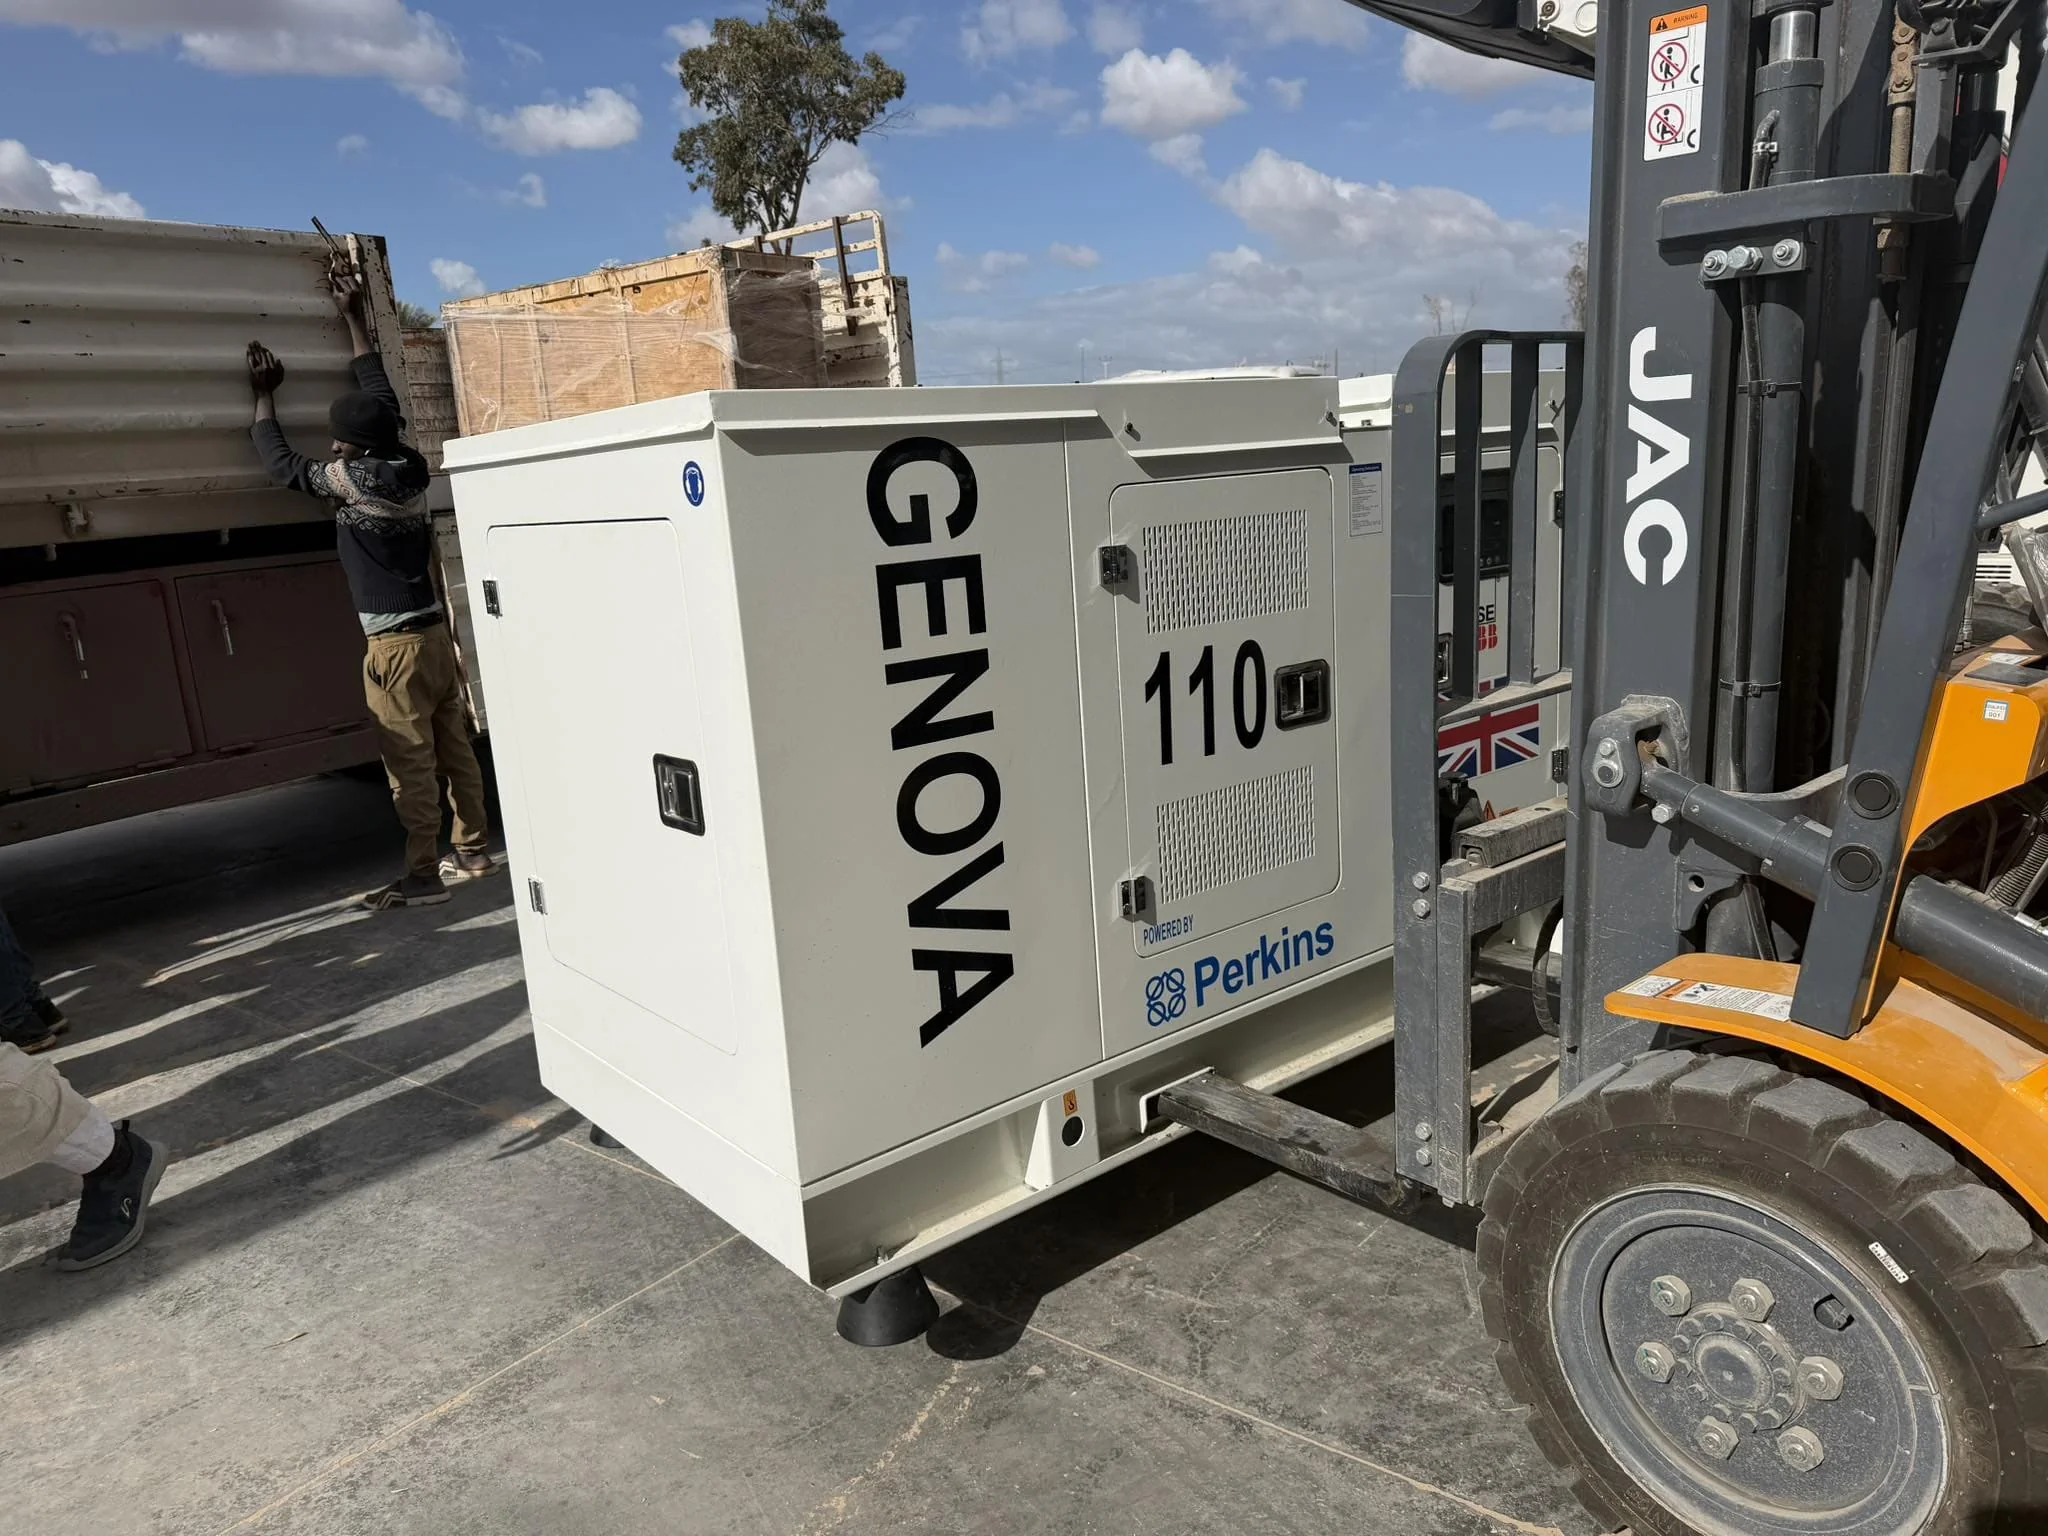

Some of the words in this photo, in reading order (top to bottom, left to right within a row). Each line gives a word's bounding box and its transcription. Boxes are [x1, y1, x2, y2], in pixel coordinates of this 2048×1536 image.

[1623, 326, 1693, 586] JAC
[1478, 624, 1498, 652] BB
[866, 436, 1015, 1049] GENOVA
[1145, 639, 1267, 766] 110
[1143, 920, 1182, 946] POWERED
[1183, 914, 1194, 932] BY
[1194, 922, 1334, 1008] Perkins
